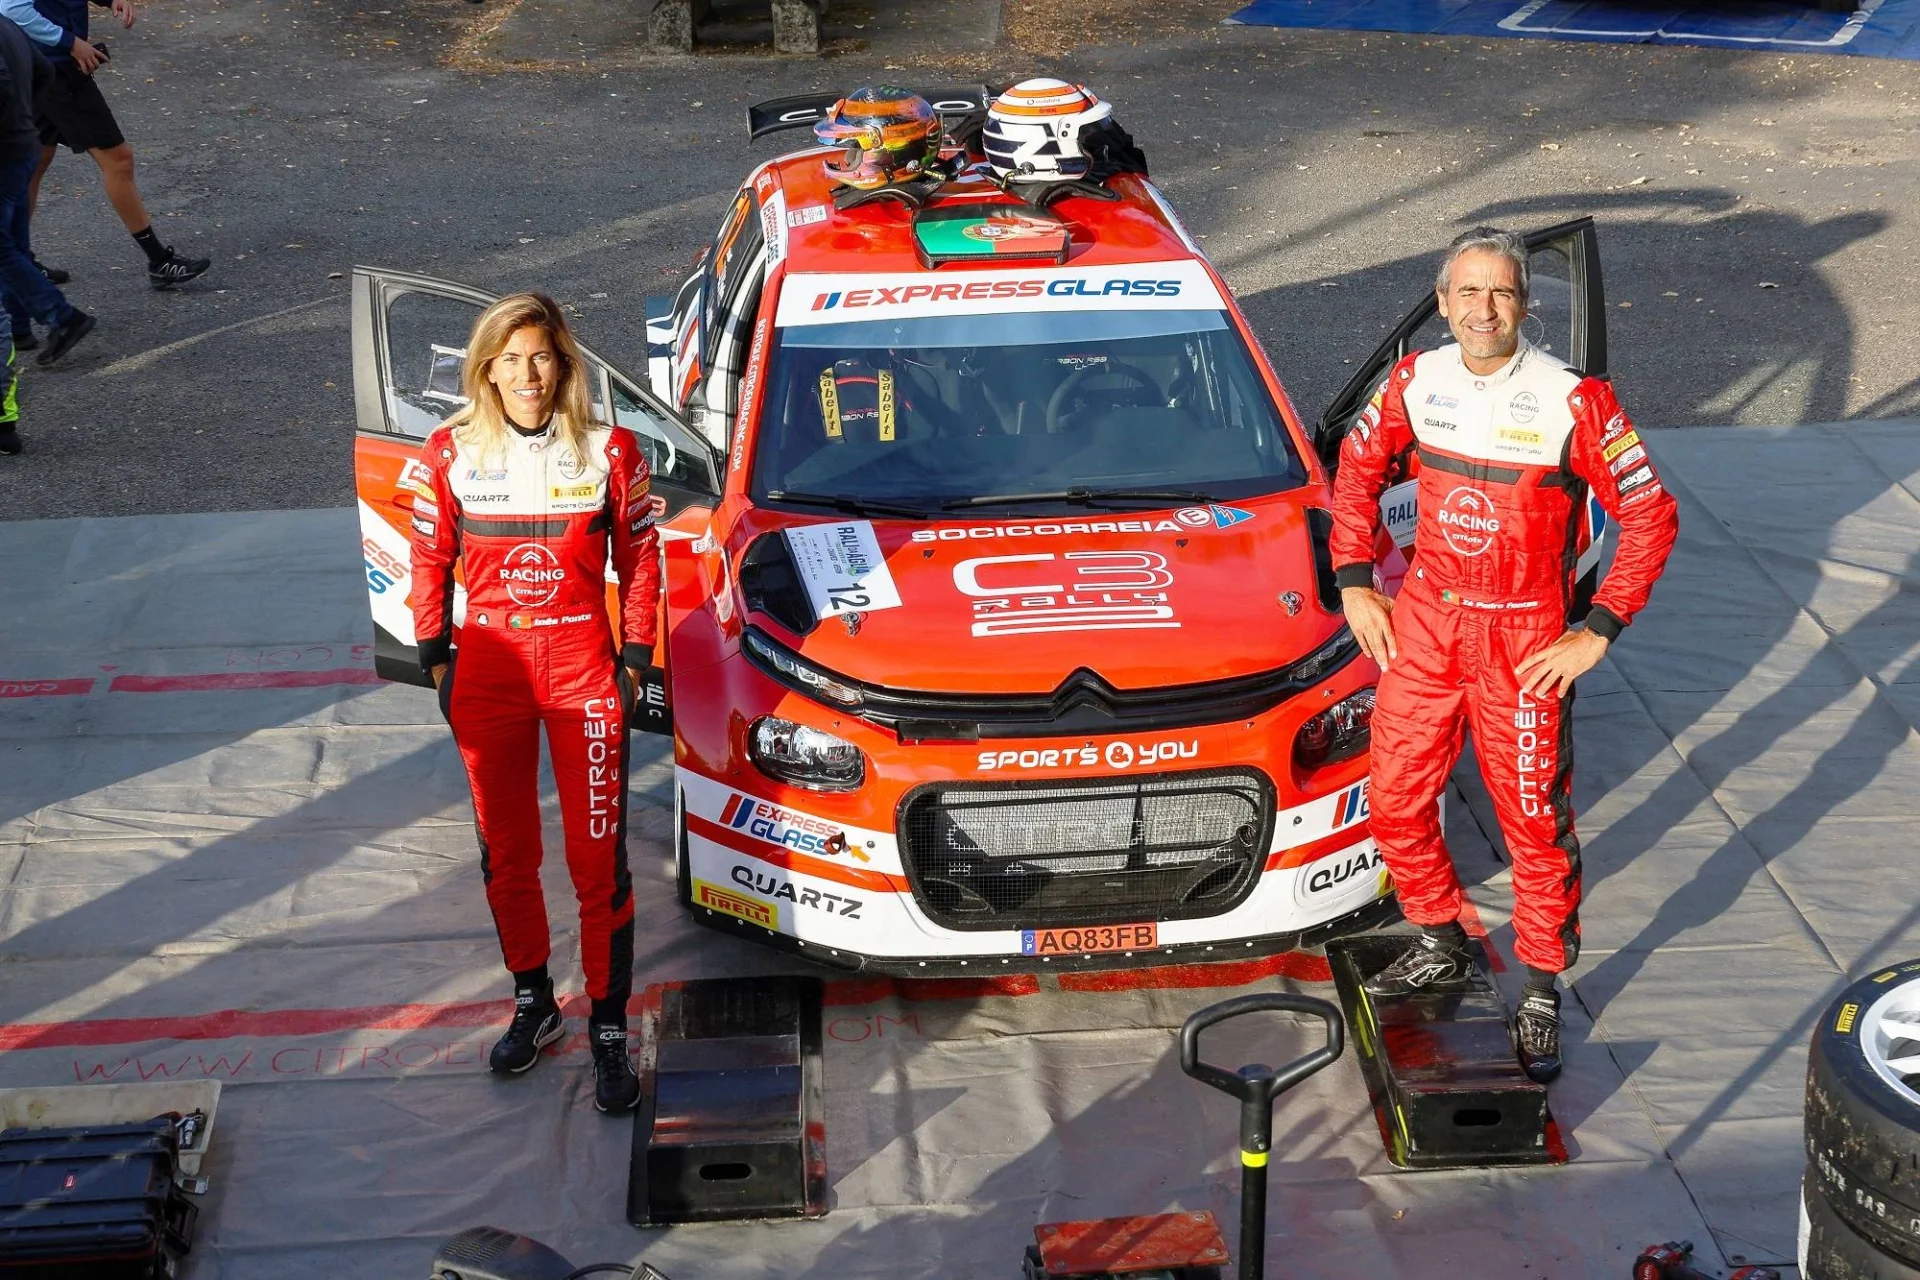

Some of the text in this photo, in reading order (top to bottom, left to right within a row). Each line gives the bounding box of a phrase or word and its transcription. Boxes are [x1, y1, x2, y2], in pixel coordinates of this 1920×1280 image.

[1509, 401, 1540, 413] RACING
[1424, 418, 1457, 431] QUARTZ
[912, 521, 1184, 543] SOCICORREIA
[1438, 510, 1499, 532] RACING
[500, 569, 565, 582] RACING
[953, 550, 1174, 597] C3
[827, 582, 871, 610] 12
[977, 745, 1098, 770] SPORTS
[1138, 740, 1198, 765] YOU
[755, 804, 839, 838] EXPRESS
[701, 886, 770, 925] PIRELLI
[731, 865, 863, 919] QUARTZ
[1039, 926, 1153, 952] AQ83FB
[1836, 1003, 1858, 1034] PIRELLI
